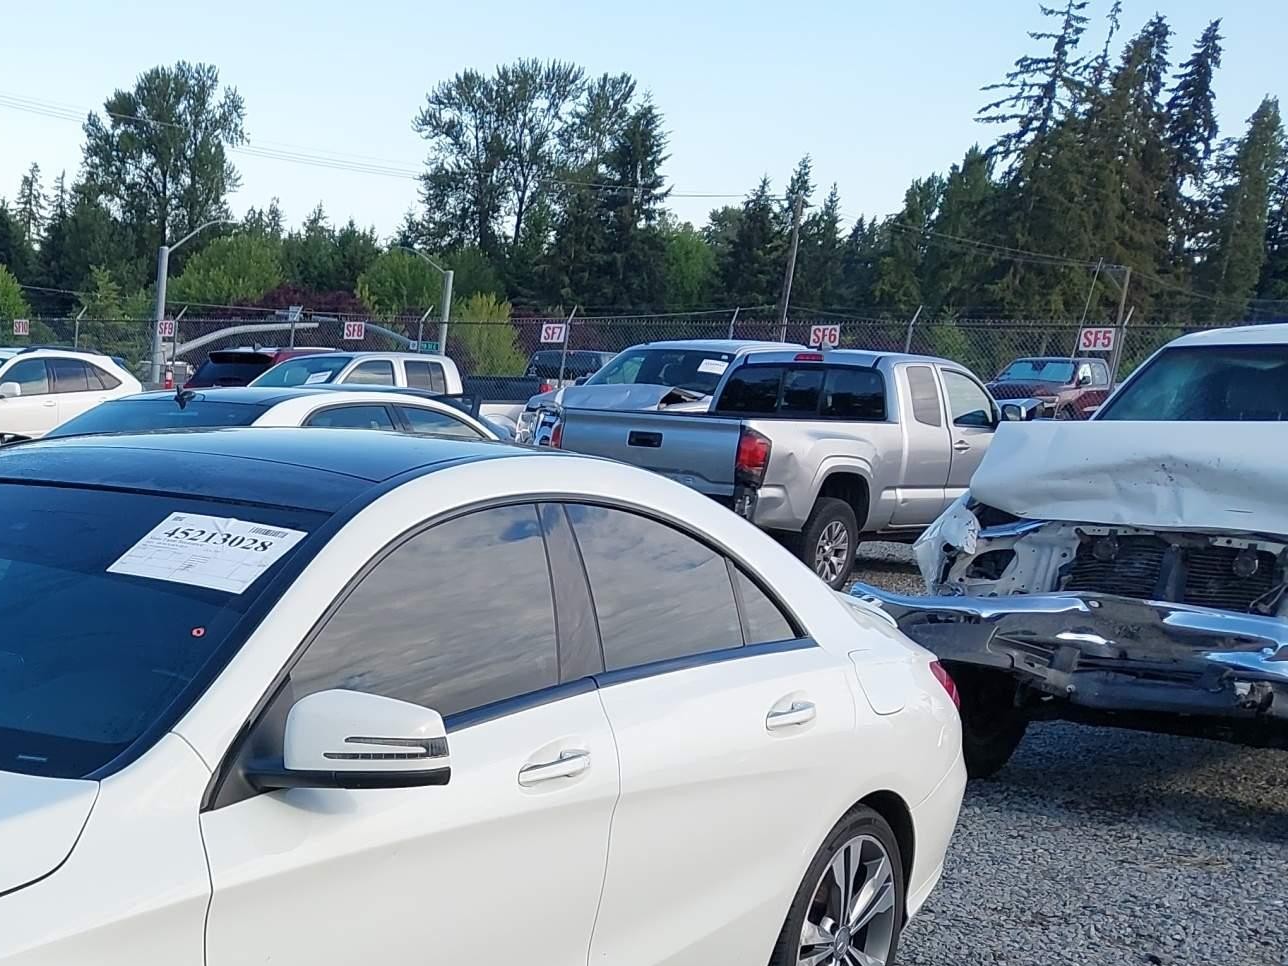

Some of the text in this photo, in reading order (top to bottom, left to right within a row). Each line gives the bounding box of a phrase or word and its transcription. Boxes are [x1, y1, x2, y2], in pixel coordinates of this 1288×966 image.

[14, 320, 29, 334] SF10
[158, 322, 174, 336] SF9
[345, 323, 363, 338] SF8
[543, 326, 564, 341] SF7
[812, 327, 837, 345] SF6
[1082, 330, 1113, 348] SF5
[164, 526, 274, 552] 45213028
